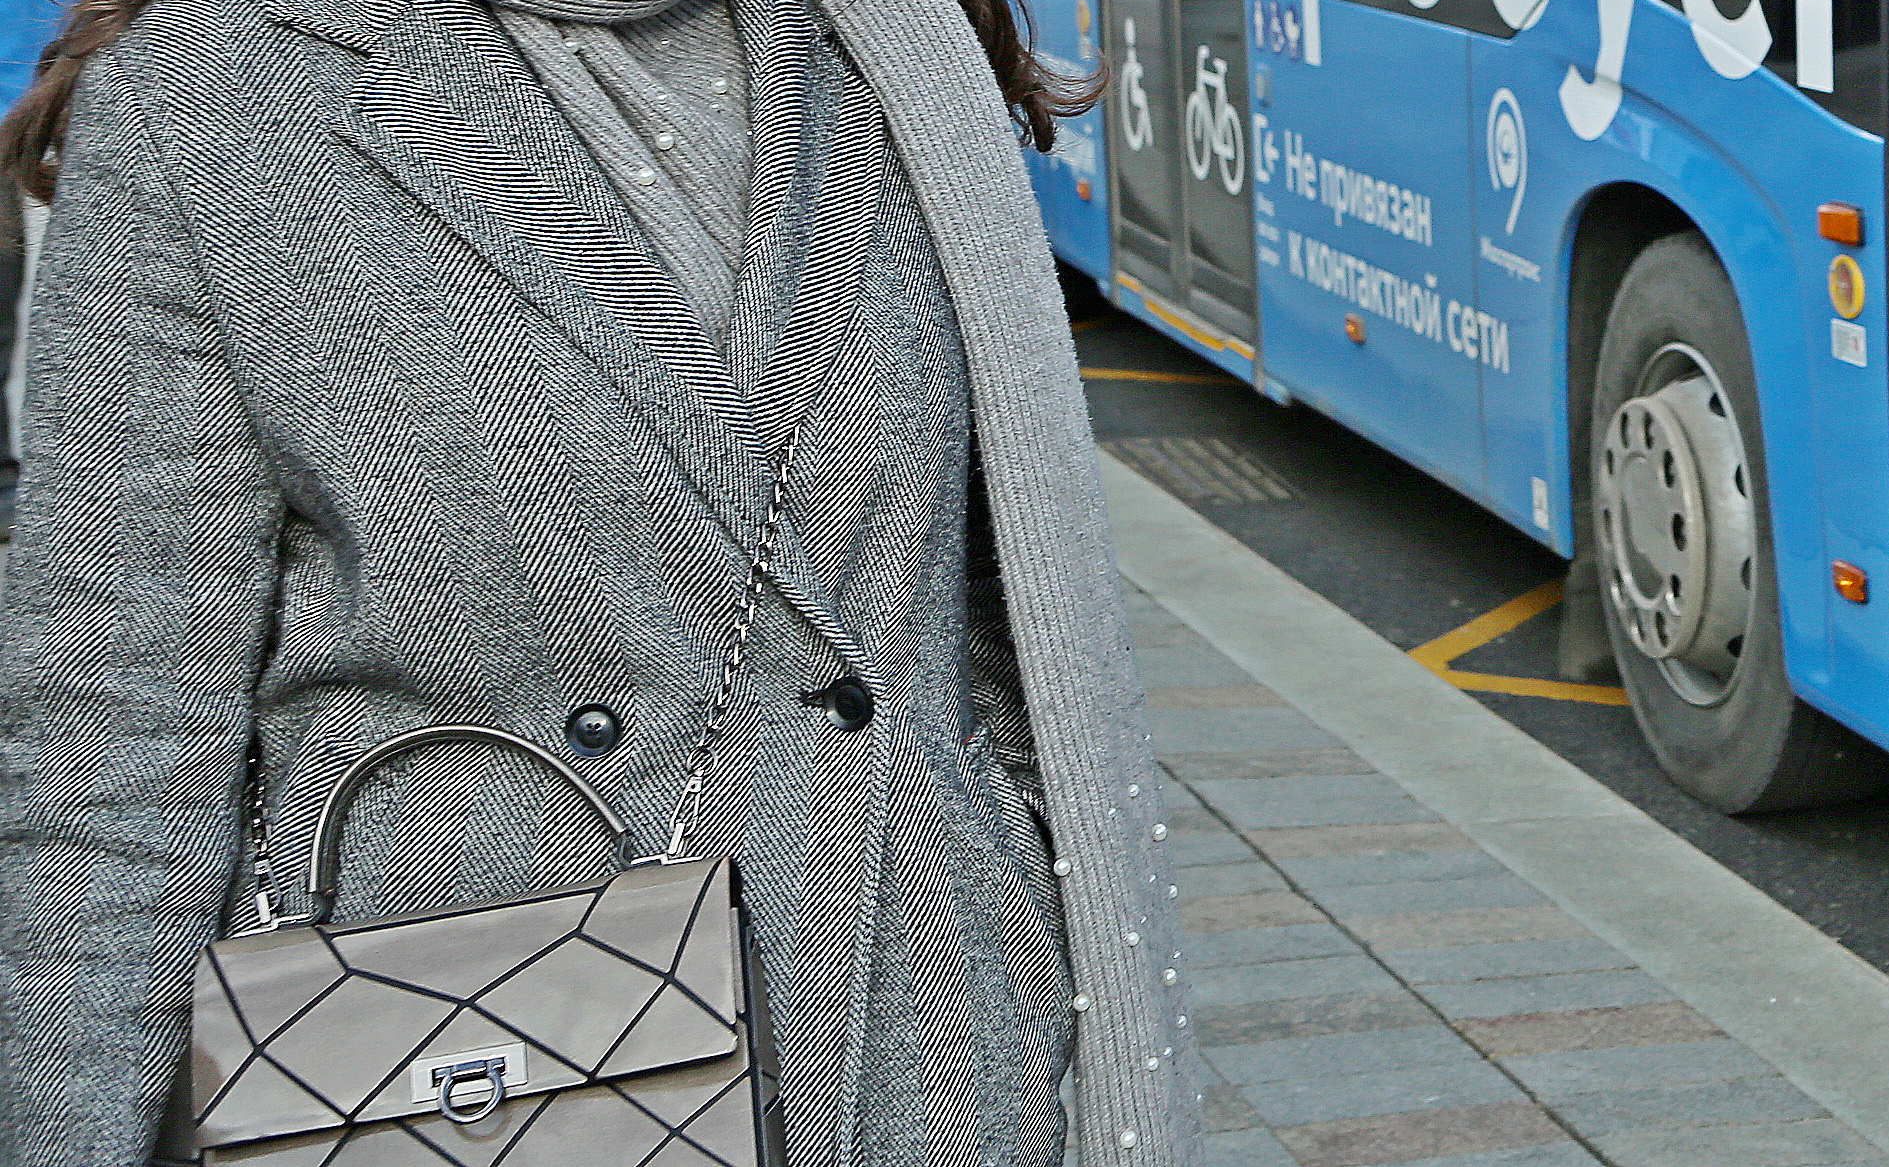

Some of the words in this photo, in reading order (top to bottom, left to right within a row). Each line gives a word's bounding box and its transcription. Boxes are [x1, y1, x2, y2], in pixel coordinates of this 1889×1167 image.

[1284, 129, 1317, 202] Не
[1320, 156, 1433, 247] привязан
[1287, 231, 1305, 280] к
[1305, 237, 1443, 343] контактной
[1446, 299, 1511, 375] сети
